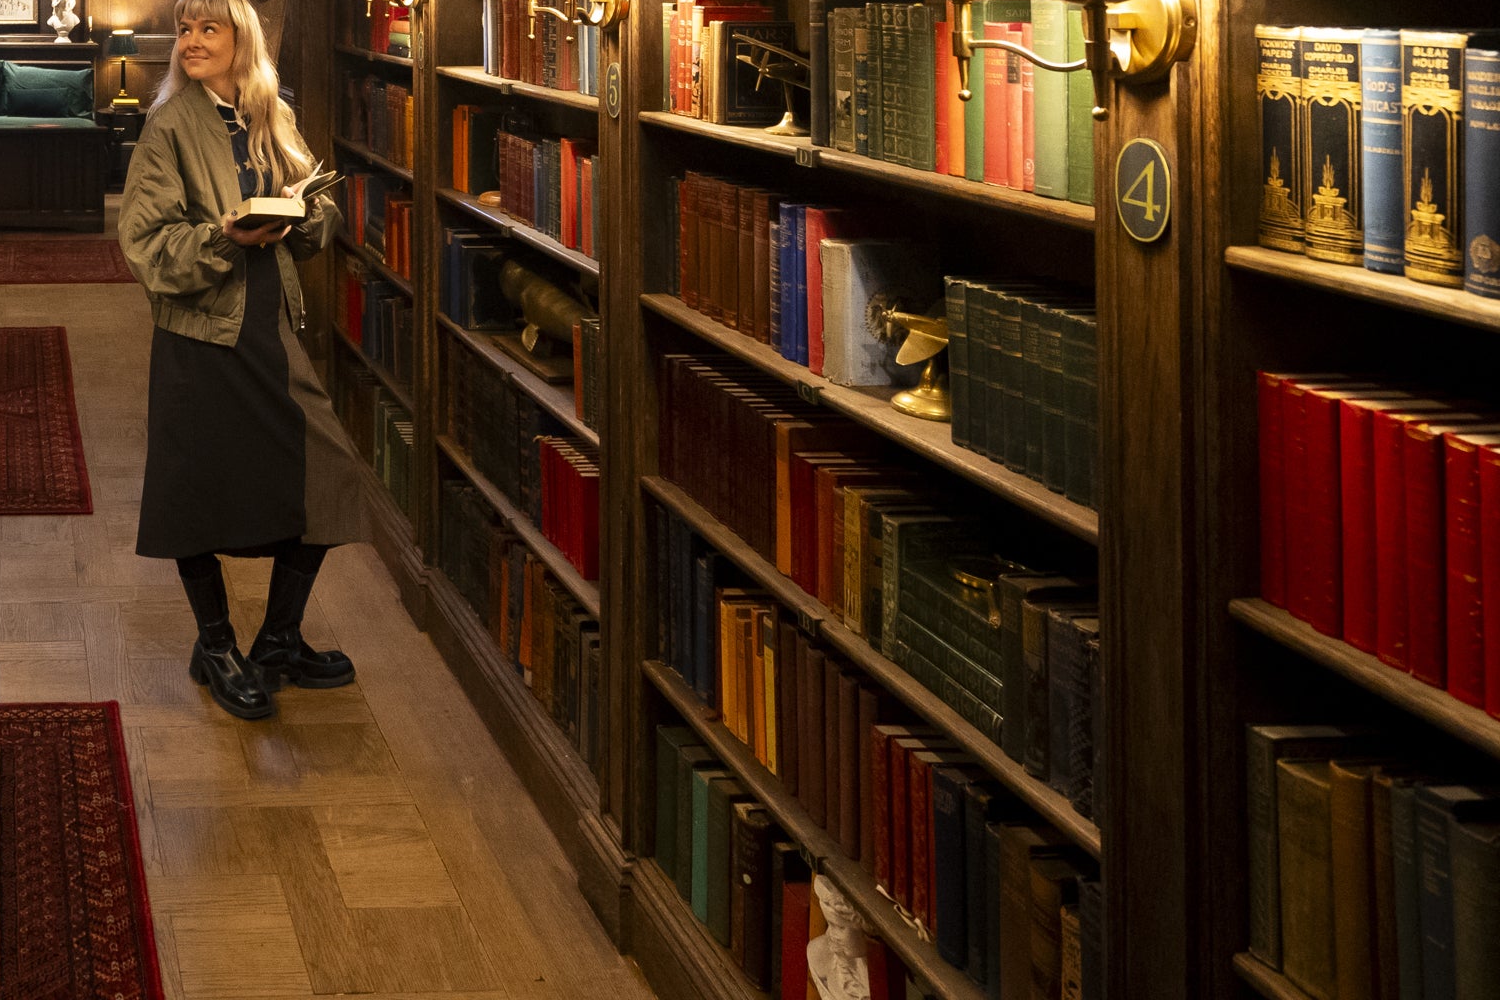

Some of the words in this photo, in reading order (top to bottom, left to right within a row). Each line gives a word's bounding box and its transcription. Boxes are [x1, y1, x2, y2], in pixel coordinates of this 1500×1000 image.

[1259, 39, 1296, 50] PICKWICK
[1313, 42, 1343, 52] DAVID
[1261, 48, 1293, 59] PAPERS
[1303, 52, 1355, 63] COPPERFIELD
[1412, 47, 1449, 58] BLEAK
[1261, 61, 1292, 71] CHARLES
[1412, 57, 1449, 69] HOUSE
[1261, 68, 1292, 77] DICKENS
[1308, 65, 1348, 75] CHARLES
[1308, 73, 1349, 82] DICKENS
[1410, 71, 1450, 82] CHARLES
[1410, 79, 1450, 89] DICKENS
[609, 74, 618, 106] 5
[799, 150, 808, 165] D
[1122, 159, 1160, 222] 4
[801, 384, 811, 400] C
[802, 613, 811, 631] B
[804, 852, 814, 868] A
